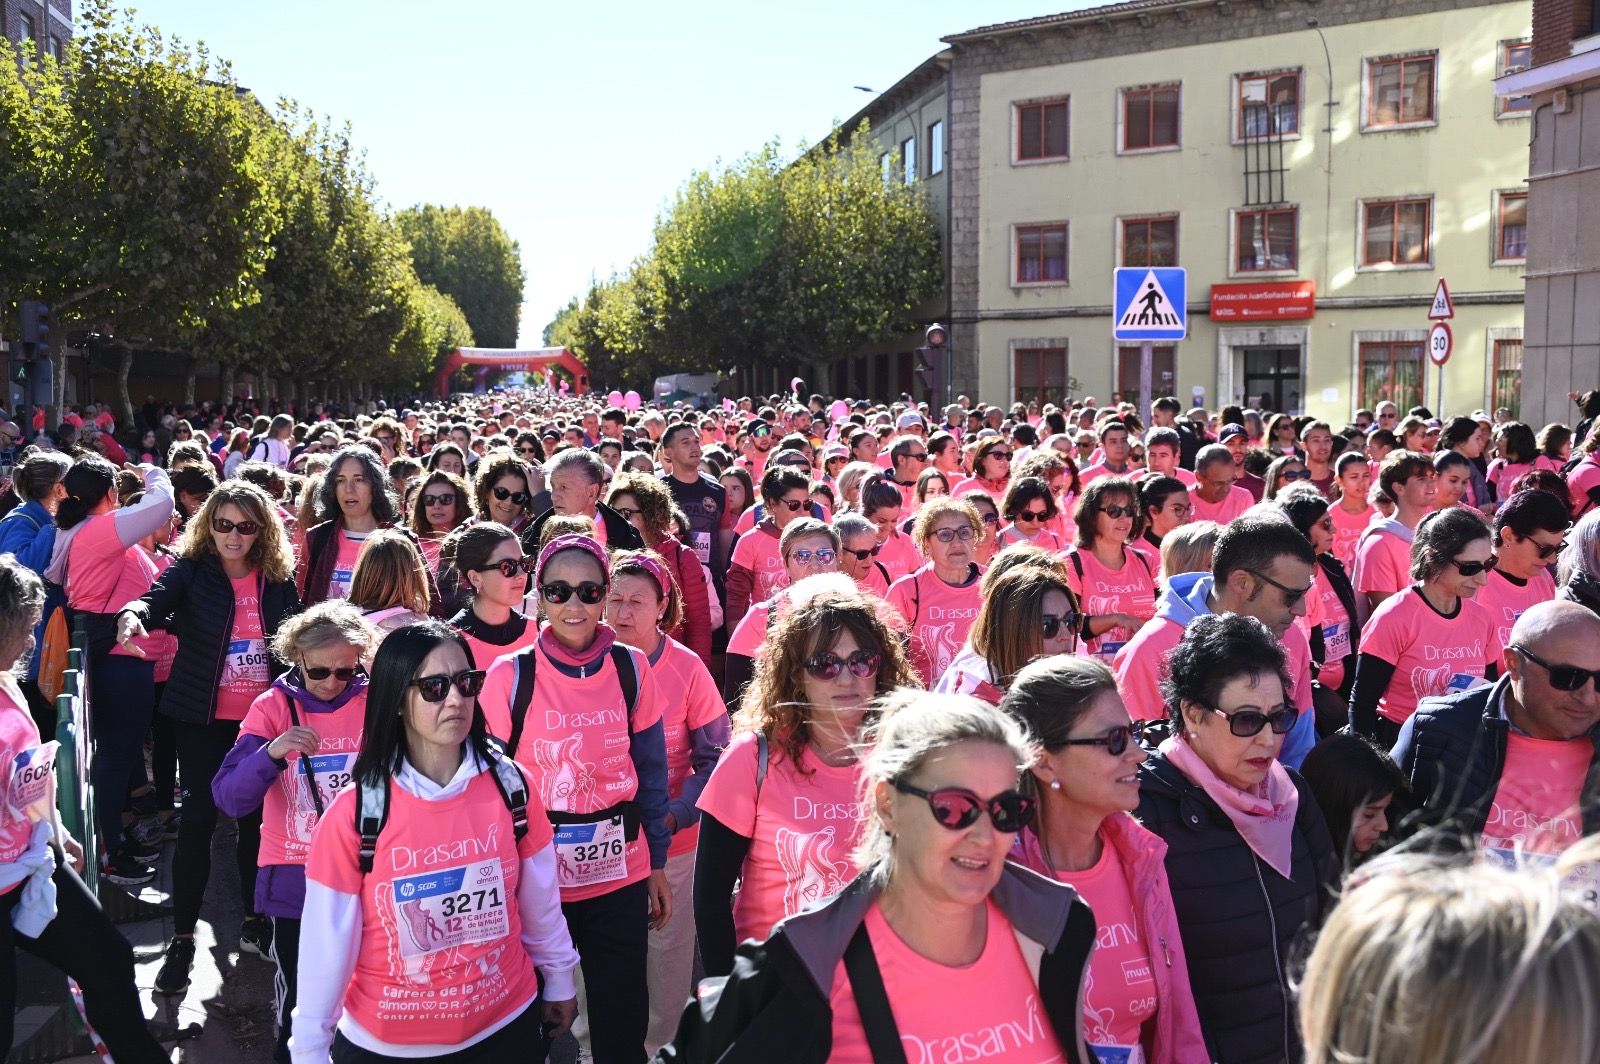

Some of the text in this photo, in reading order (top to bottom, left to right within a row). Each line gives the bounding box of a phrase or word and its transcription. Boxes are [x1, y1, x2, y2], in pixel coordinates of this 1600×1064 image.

[1433, 336, 1446, 350] 30
[1330, 631, 1349, 647] 3623
[236, 653, 268, 667] 1605
[18, 761, 50, 788] 1609
[574, 839, 623, 862] 3276
[402, 882, 414, 896] hp
[476, 874, 499, 886] almom
[441, 887, 503, 917] 3271
[467, 909, 503, 922] Carrera
[467, 916, 503, 929] de la Mujer
[383, 985, 435, 999] Carrera
[440, 986, 458, 997] de
[461, 984, 474, 996] la
[377, 1012, 415, 1020] Contra
[474, 1005, 485, 1013] de
[378, 1000, 420, 1011] almom
